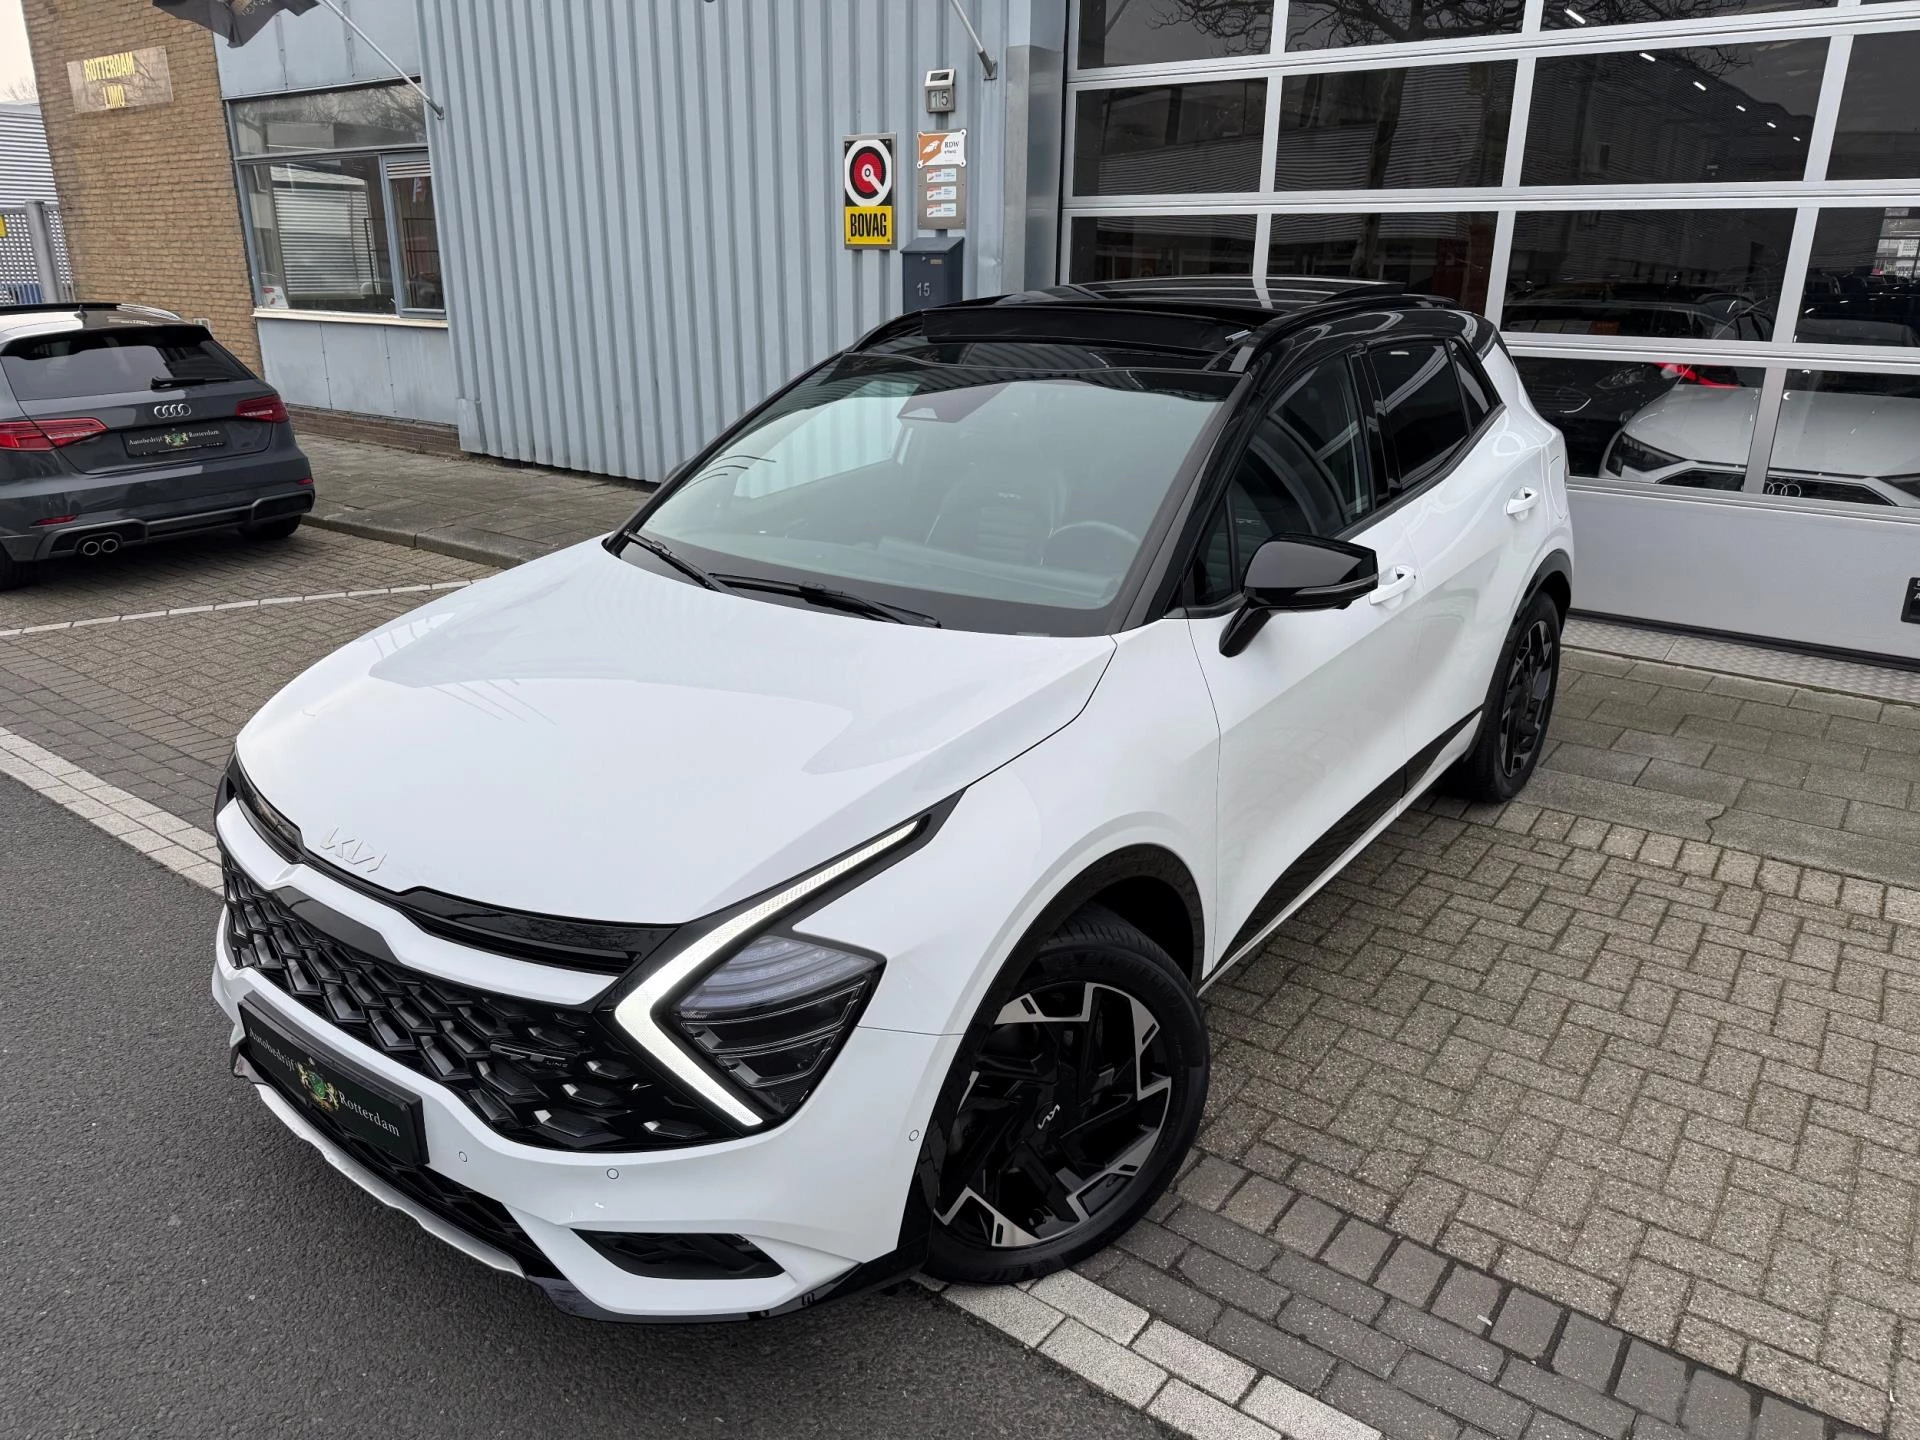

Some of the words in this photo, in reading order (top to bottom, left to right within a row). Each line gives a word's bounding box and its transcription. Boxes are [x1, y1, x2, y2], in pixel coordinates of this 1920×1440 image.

[83, 51, 136, 82] ROTTERDAM
[932, 90, 948, 107] 15
[850, 212, 887, 238] BOVAG
[916, 282, 930, 296] 15
[249, 1027, 296, 1072] Autobedrijf
[337, 1090, 400, 1137] Rotterdam
